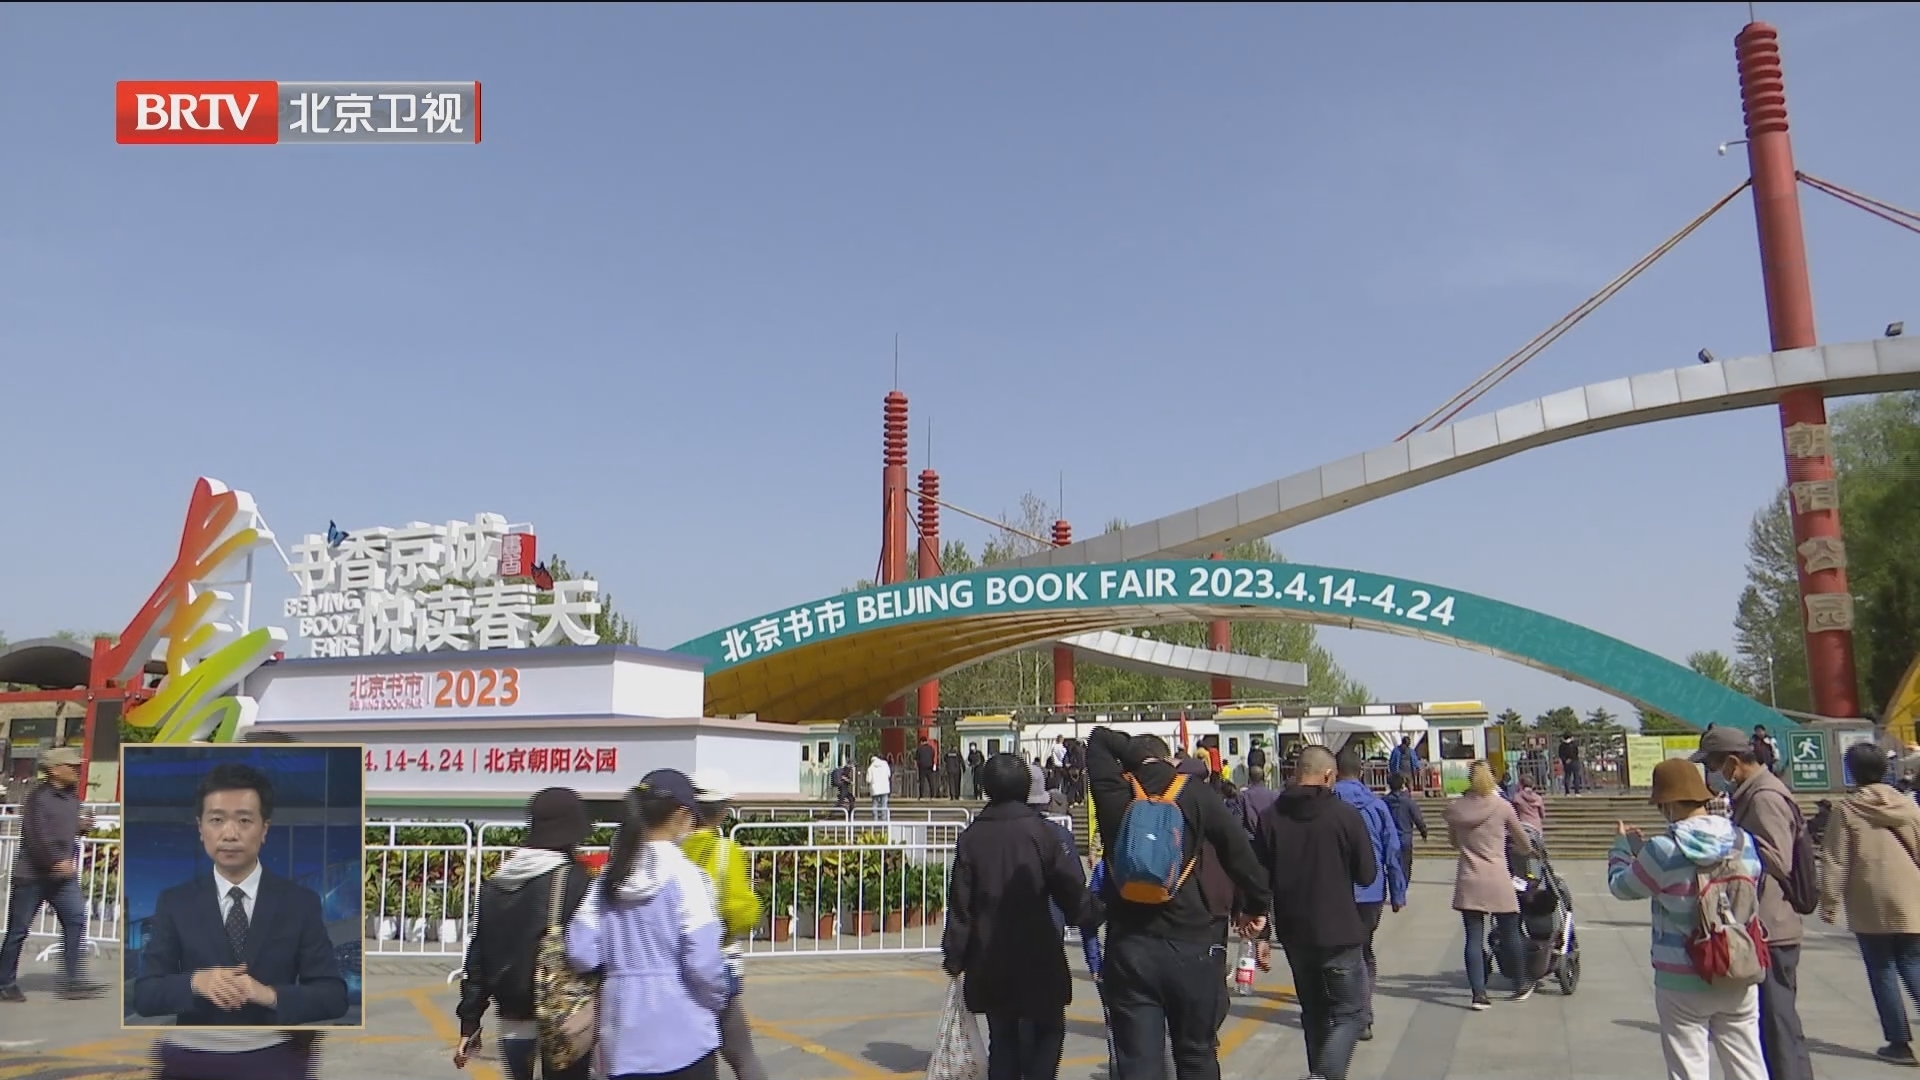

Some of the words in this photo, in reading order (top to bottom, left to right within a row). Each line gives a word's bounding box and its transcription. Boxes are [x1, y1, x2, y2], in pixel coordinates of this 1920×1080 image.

[288, 512, 508, 594] 书香京城
[284, 591, 362, 617] BEIJING
[362, 578, 602, 656] 悦读春天
[720, 600, 846, 662] 北京书市
[857, 580, 973, 624] BEIJING
[986, 572, 1089, 606] BOOK
[1101, 567, 1177, 600] FAIR
[1189, 567, 1455, 626] 2023.4.14-4.24
[299, 614, 360, 639] BOOK
[311, 636, 360, 659] FAIR
[349, 672, 424, 699] 北京书市
[434, 667, 521, 708] 2023
[484, 747, 618, 774] 北京朝阳公园
